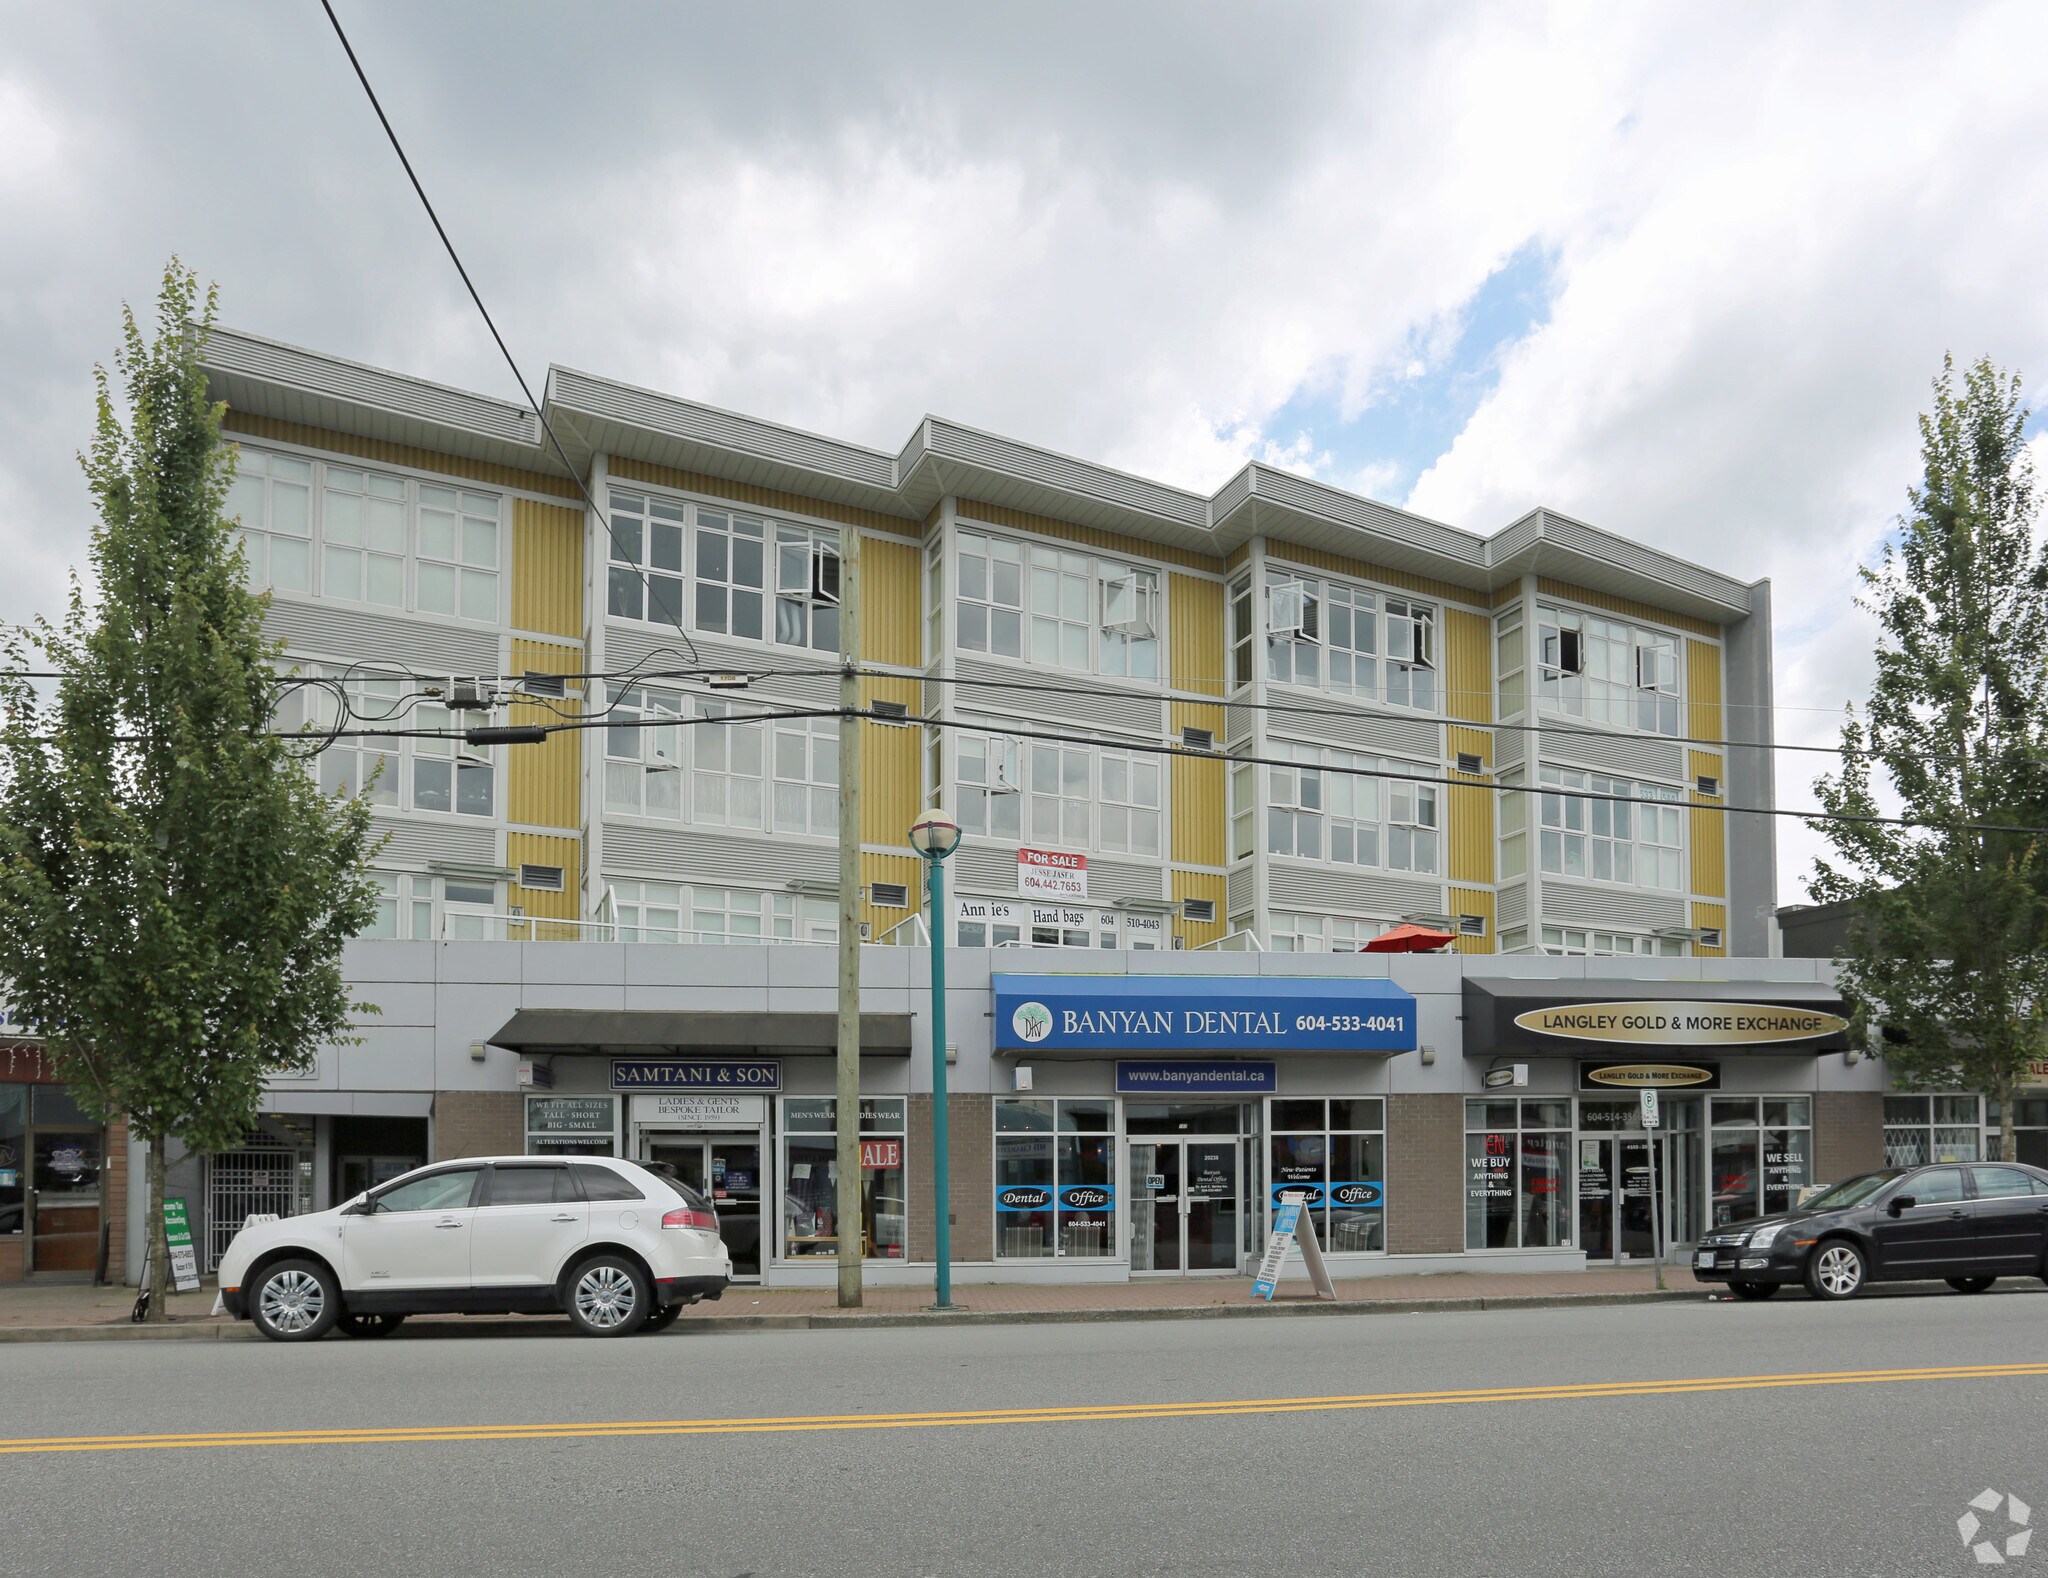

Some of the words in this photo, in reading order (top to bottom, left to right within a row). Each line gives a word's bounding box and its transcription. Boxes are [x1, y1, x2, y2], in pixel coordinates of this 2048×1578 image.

[1027, 852, 1048, 864] FOR
[1052, 855, 1078, 867] SALE
[1031, 868, 1052, 878] JESSE
[1052, 870, 1075, 880] JASER
[1024, 876, 1082, 892] 604.442.7653
[1032, 910, 1059, 923] Hand
[1063, 909, 1084, 926] bags
[1100, 914, 1114, 925] 604
[1126, 918, 1160, 930] 510-4043
[1063, 1010, 1173, 1034] BANYAN
[1184, 1011, 1287, 1035] DENTAL
[1296, 1015, 1404, 1032] 604-533-4041
[1544, 1015, 1617, 1029] LANGLEY
[1622, 1016, 1667, 1030] GOLD
[1671, 1016, 1682, 1030] &
[1686, 1016, 1732, 1030] MORE
[1737, 1017, 1822, 1031] EXCHANGE
[616, 1067, 711, 1082] SAMTANI
[717, 1068, 731, 1082] &
[736, 1068, 775, 1082] SON
[1128, 1070, 1264, 1084] www.banyandental.ca
[1599, 1072, 1626, 1080] LANGLEY
[1627, 1072, 1644, 1080] GOLD
[1652, 1072, 1670, 1080] MORE
[1671, 1072, 1702, 1080] EXCHANGE
[658, 1106, 701, 1114] BESPOKE
[704, 1106, 740, 1114] TAILOR
[862, 1144, 898, 1166] ALE
[1766, 1154, 1781, 1162] WE
[1784, 1153, 1804, 1162] SELL
[1471, 1158, 1488, 1168] WE
[1490, 1158, 1510, 1168] BUY
[1148, 1176, 1162, 1185] OPEN
[1474, 1172, 1508, 1180] ANYTHING
[1004, 1192, 1046, 1204] Dental
[1070, 1190, 1104, 1206] Office
[1340, 1188, 1372, 1203] Office
